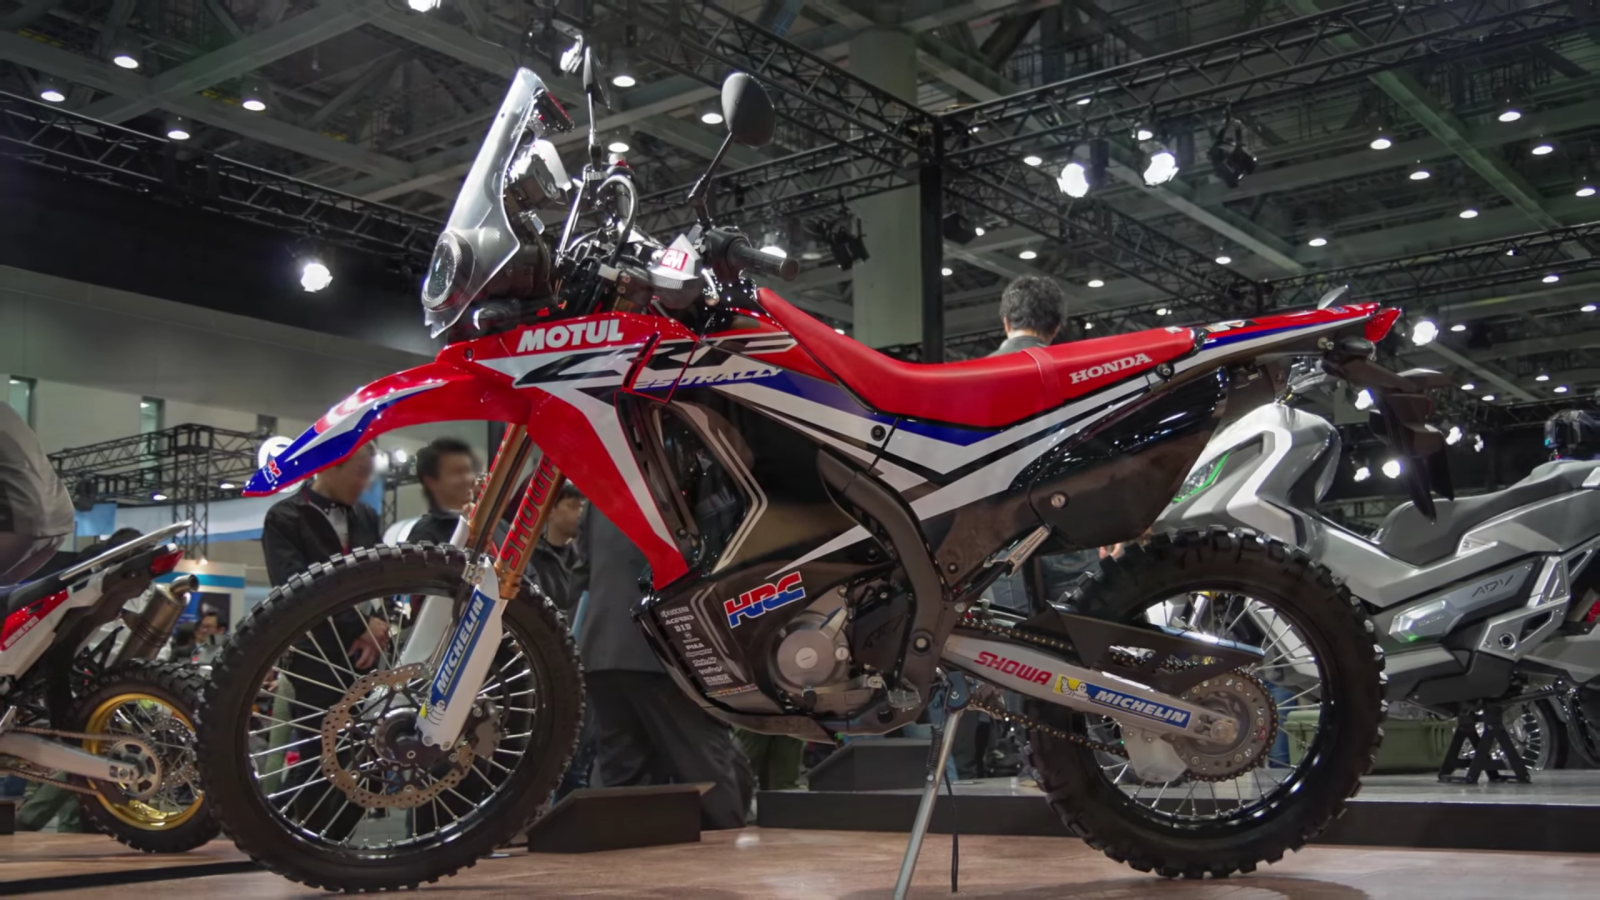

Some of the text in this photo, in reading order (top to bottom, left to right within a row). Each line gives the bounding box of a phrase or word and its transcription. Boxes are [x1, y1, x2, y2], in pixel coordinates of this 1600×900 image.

[517, 319, 624, 353] MOTUL
[1070, 353, 1152, 385] HONDA
[723, 571, 806, 629] HRC
[1472, 574, 1515, 598] ADV
[437, 595, 485, 694] MICHELIN
[973, 650, 1053, 686] SHOWA
[1094, 690, 1188, 723] MICHELIN
